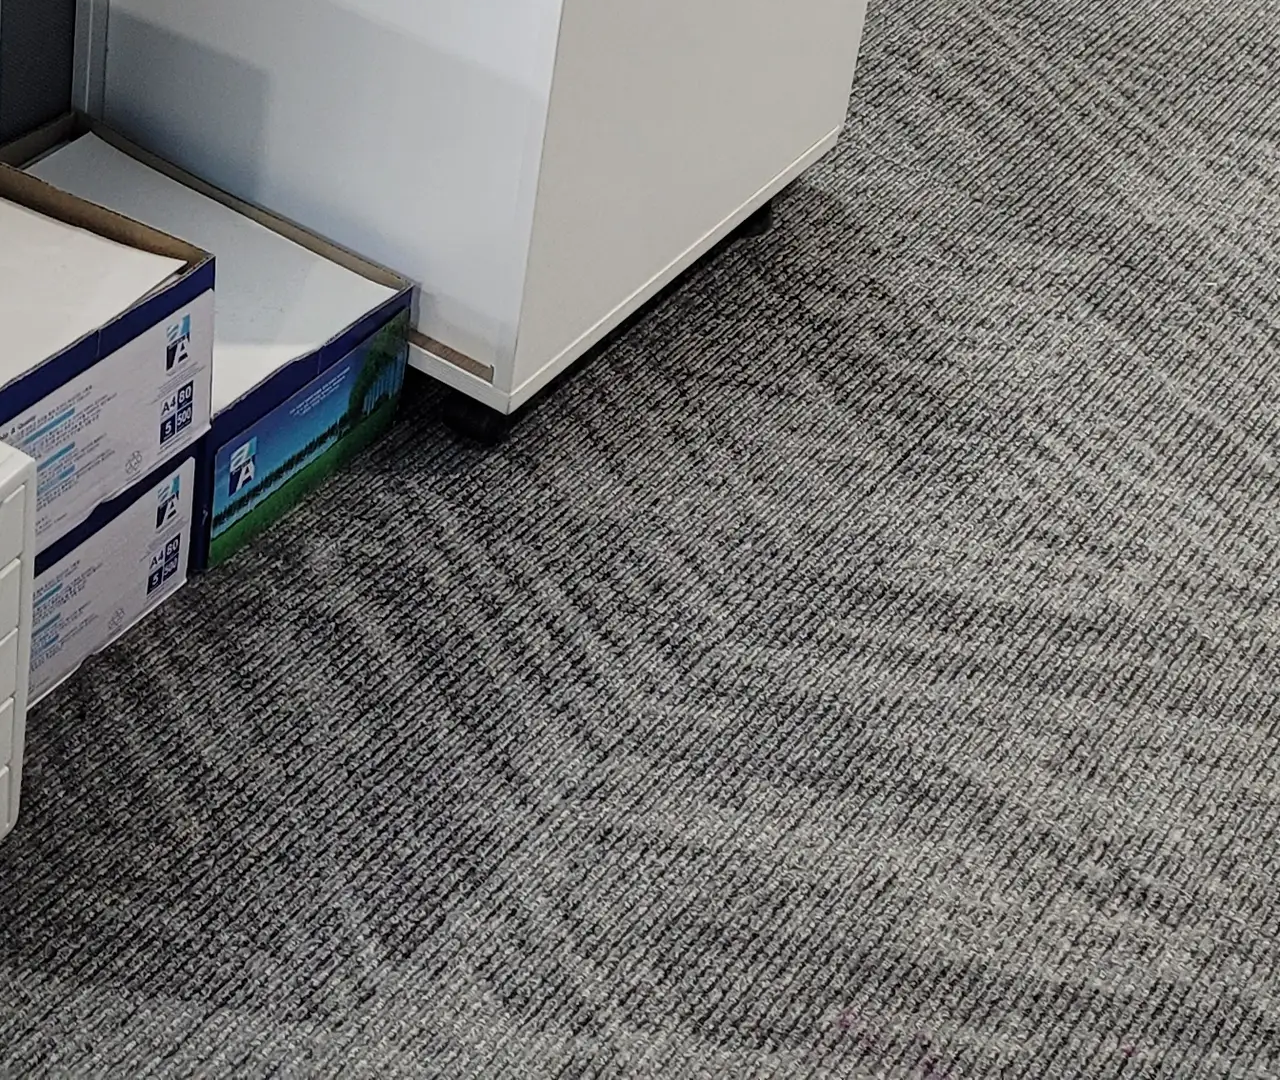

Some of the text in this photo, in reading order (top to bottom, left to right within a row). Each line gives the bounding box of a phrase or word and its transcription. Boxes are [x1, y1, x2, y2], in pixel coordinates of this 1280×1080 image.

[161, 385, 192, 416] A4 80
[165, 406, 192, 435] 5 500
